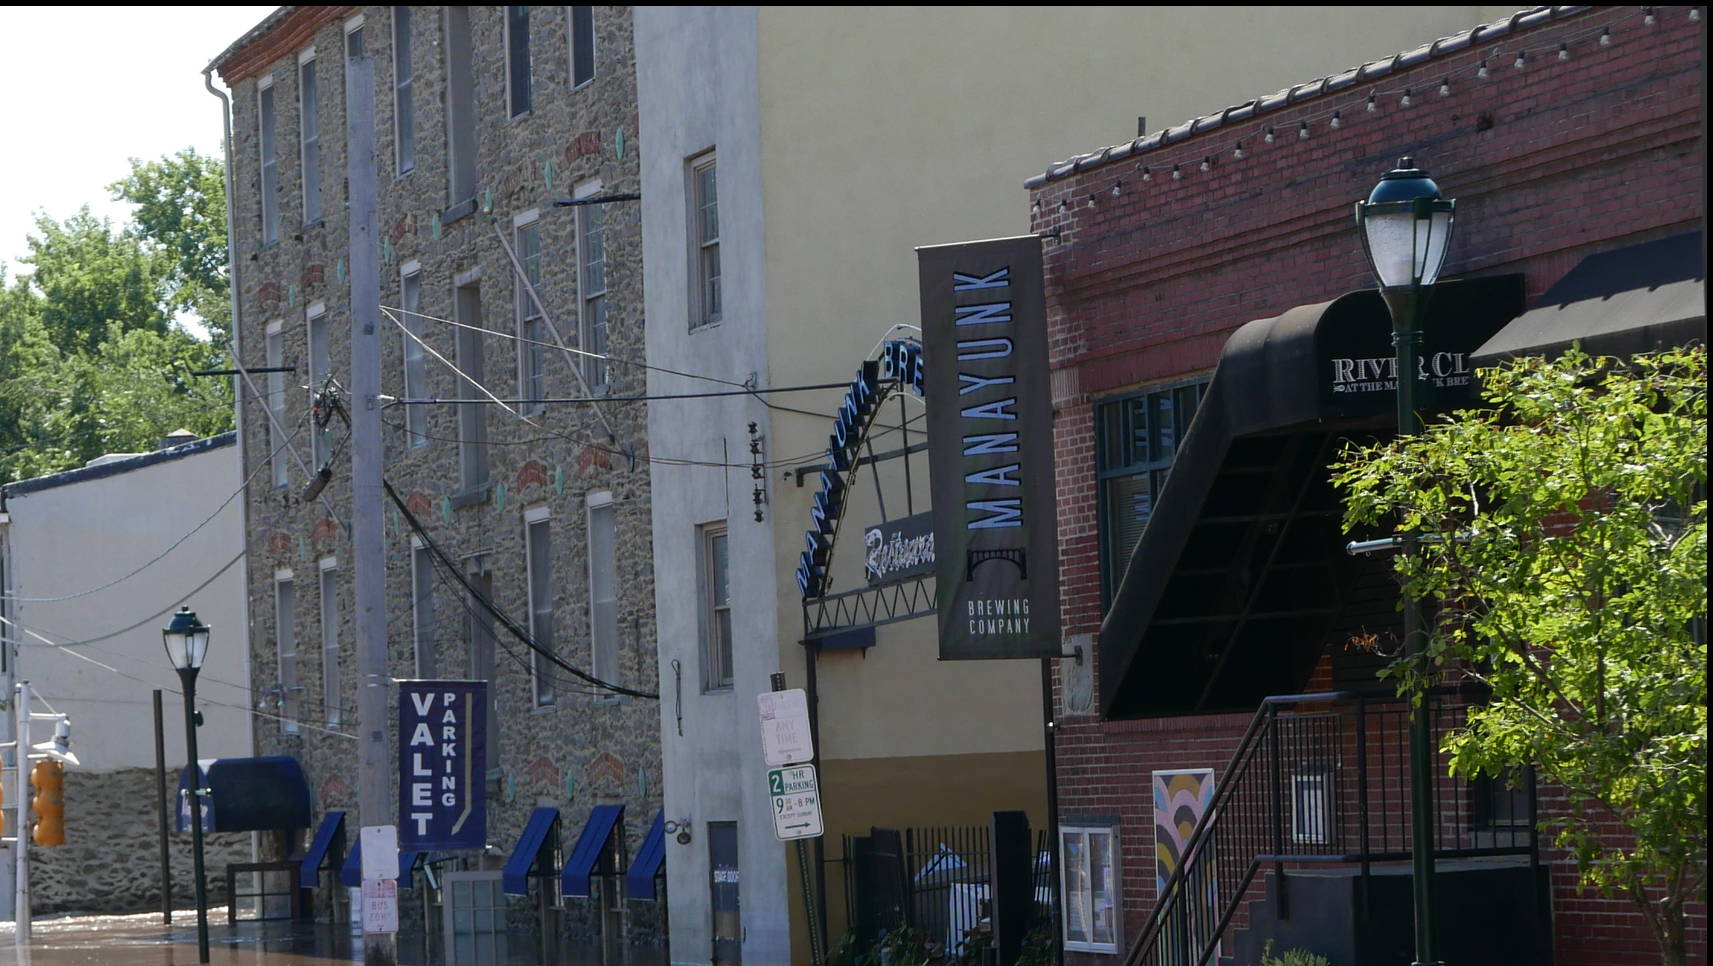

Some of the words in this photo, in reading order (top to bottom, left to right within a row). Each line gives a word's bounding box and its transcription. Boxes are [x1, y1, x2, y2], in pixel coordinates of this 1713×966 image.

[1432, 351, 1470, 378] CL
[1359, 381, 1383, 392] THE
[953, 264, 1023, 530] MANAYUNK
[967, 599, 1030, 617] BREWING
[968, 617, 1030, 636] COMPANY
[776, 733, 799, 746] TIME
[441, 692, 457, 807] PARKING
[410, 692, 435, 836] VALET
[770, 775, 782, 793] 2
[792, 769, 805, 780] HR
[784, 779, 815, 793] PARKING
[776, 797, 785, 815] 9
[804, 796, 816, 807] PM
[371, 900, 389, 911] BUS
